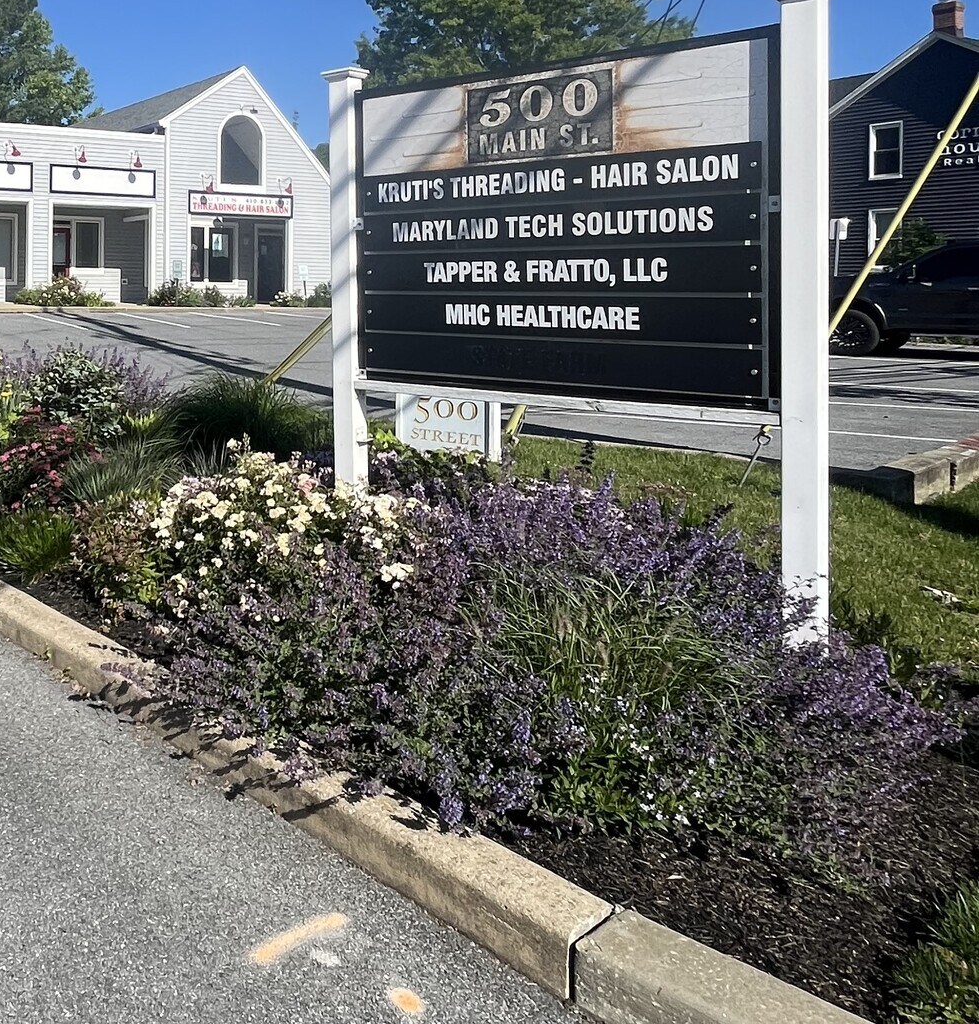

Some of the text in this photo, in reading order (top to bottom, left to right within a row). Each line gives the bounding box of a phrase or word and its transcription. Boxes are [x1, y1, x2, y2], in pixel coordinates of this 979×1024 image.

[479, 78, 598, 126] 500
[479, 123, 599, 155] MAIN ST.
[378, 178, 444, 203] KRUTI'S
[450, 168, 565, 198] THREADING
[591, 162, 648, 189] HAIR
[656, 153, 739, 185] SALON
[192, 202, 237, 212] THREADING
[246, 204, 264, 213] HAIR
[266, 205, 289, 214] SALON
[392, 205, 714, 243] MARYLAND TECH SOLUTIONS
[423, 257, 668, 287] TAPPER & FRATTO, LLC
[445, 303, 640, 331] MHC HEALTHCARE
[414, 395, 478, 424] 500
[410, 428, 482, 446] STREET
